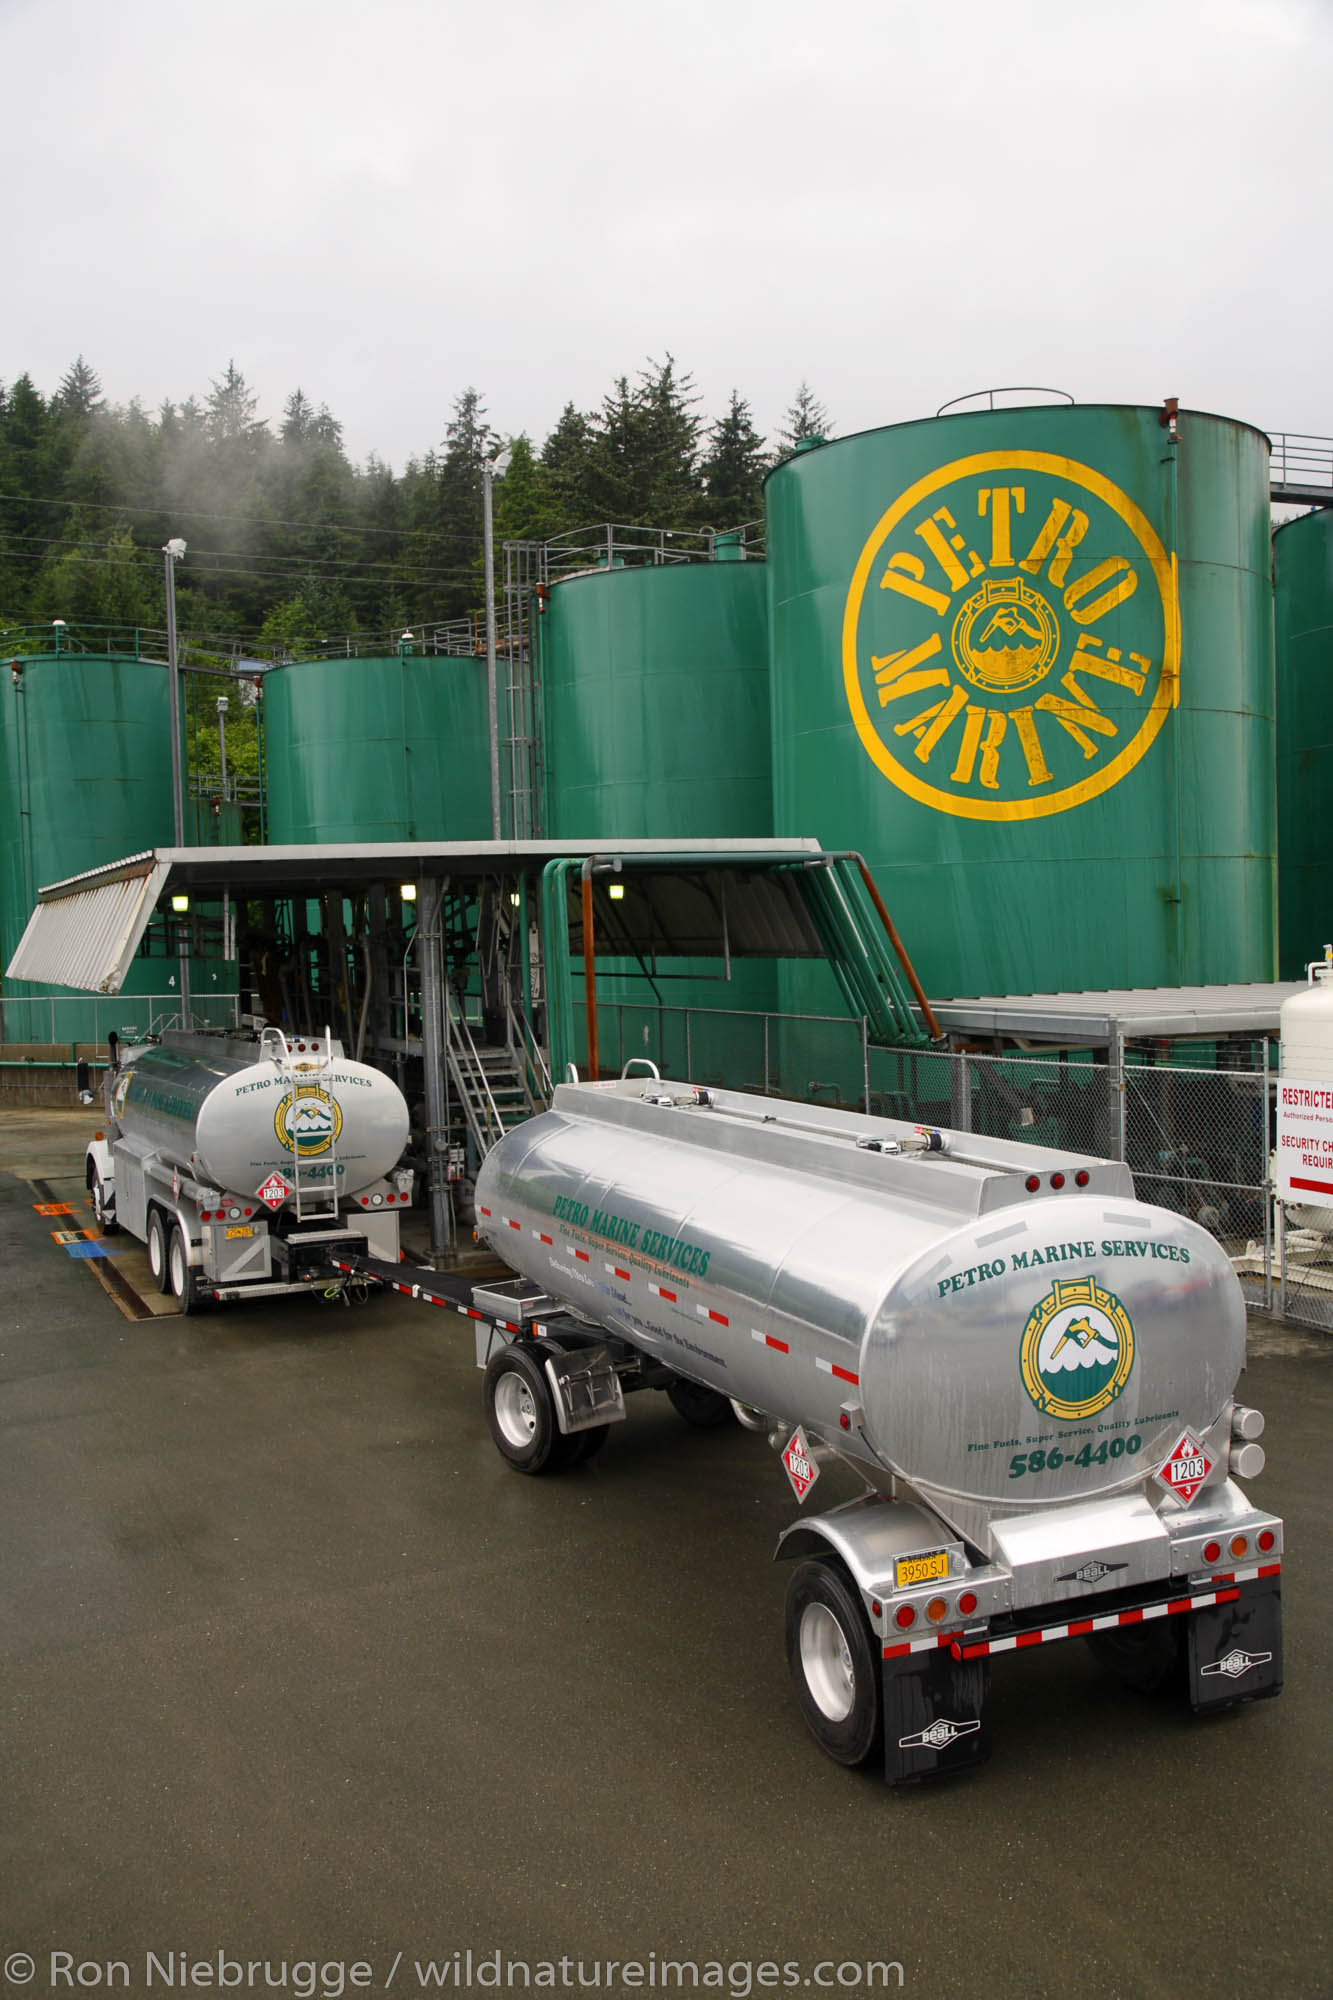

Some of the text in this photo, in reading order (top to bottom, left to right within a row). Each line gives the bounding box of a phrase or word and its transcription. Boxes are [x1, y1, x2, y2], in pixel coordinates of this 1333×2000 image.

[880, 487, 1138, 626] PETRO
[871, 632, 1151, 789] MARINE
[168, 975, 176, 987] 4
[235, 1079, 271, 1097] PETRO
[322, 1074, 373, 1088] RVICES
[1282, 1088, 1333, 1109] RESTRICTE
[1283, 1111, 1313, 1121] Authorized
[1281, 1135, 1319, 1151] SECURITY
[263, 1187, 284, 1199] 1203
[552, 1194, 711, 1277] PETRO MARINE SERVICES
[937, 1240, 1191, 1298] PETRO MARINE SERVICES
[967, 1410, 1180, 1452] Fine Fuels, Super Service, Quality Lubricants
[791, 1455, 809, 1479] 1203
[1008, 1434, 1142, 1479] 586-4400
[1174, 1458, 1204, 1480] 1203
[1185, 1485, 1191, 1495] 3
[901, 1560, 944, 1582] 3950 SJ
